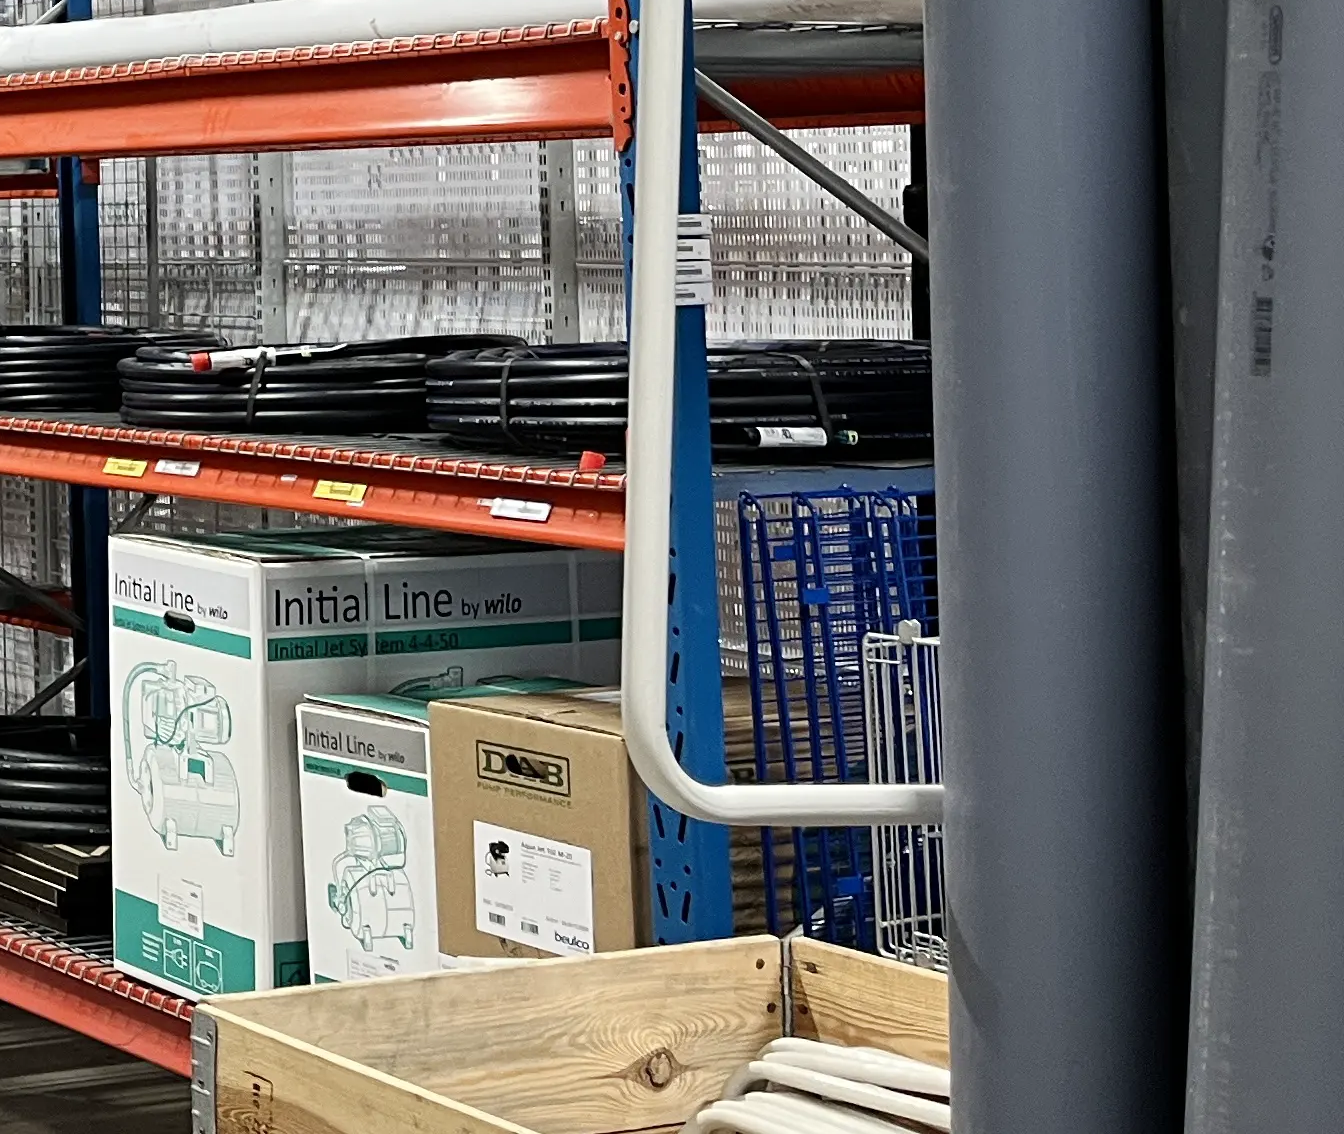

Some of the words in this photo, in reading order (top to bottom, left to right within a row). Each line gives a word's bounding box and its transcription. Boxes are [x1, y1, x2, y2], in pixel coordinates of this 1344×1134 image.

[114, 572, 157, 604] Initial
[161, 583, 194, 612] Line
[197, 603, 208, 618] by
[209, 605, 229, 620] wilo
[274, 581, 369, 627] Initial
[384, 581, 453, 621] Line
[461, 598, 480, 620] by
[484, 593, 522, 616] wilo
[274, 639, 319, 660] Initial
[322, 638, 348, 657] Jet
[350, 632, 405, 658] Sytem
[304, 727, 343, 751] Initial
[346, 734, 376, 758] Line
[481, 748, 565, 788] DAB
[554, 929, 590, 950] beulco
